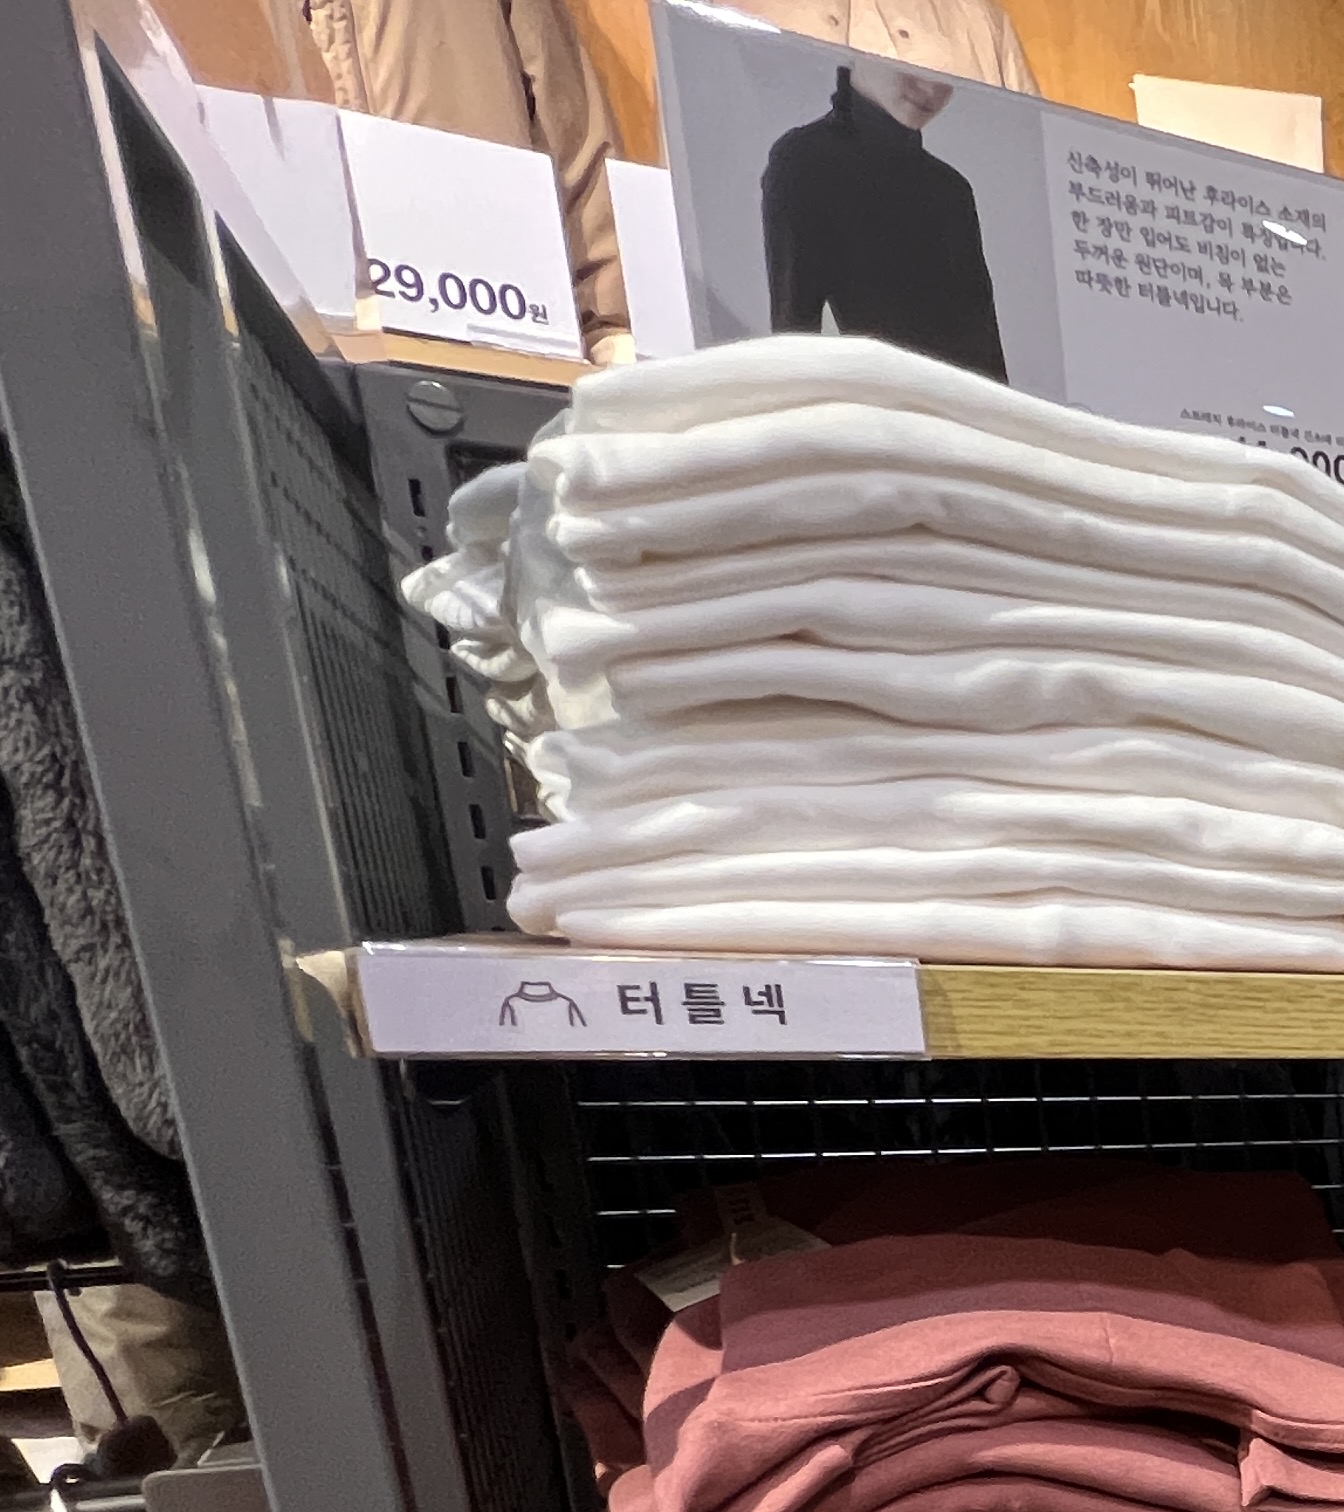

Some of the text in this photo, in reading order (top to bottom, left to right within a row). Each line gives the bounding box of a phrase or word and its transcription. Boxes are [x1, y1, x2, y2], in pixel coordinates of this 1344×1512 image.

[1067, 151, 1327, 232] 신축성이 뛰어난 후라이스 소재의
[1068, 180, 1157, 216] 부드러움과
[1164, 205, 1233, 238] 피트감이
[1071, 210, 1286, 278] 한 장만 입어도 비침이 없는
[1074, 239, 1128, 268] 두꺼운
[1218, 272, 1235, 293] 목
[1241, 276, 1292, 305] 부분은
[1075, 269, 1244, 322] 따뜻한 터틀넥입니다.
